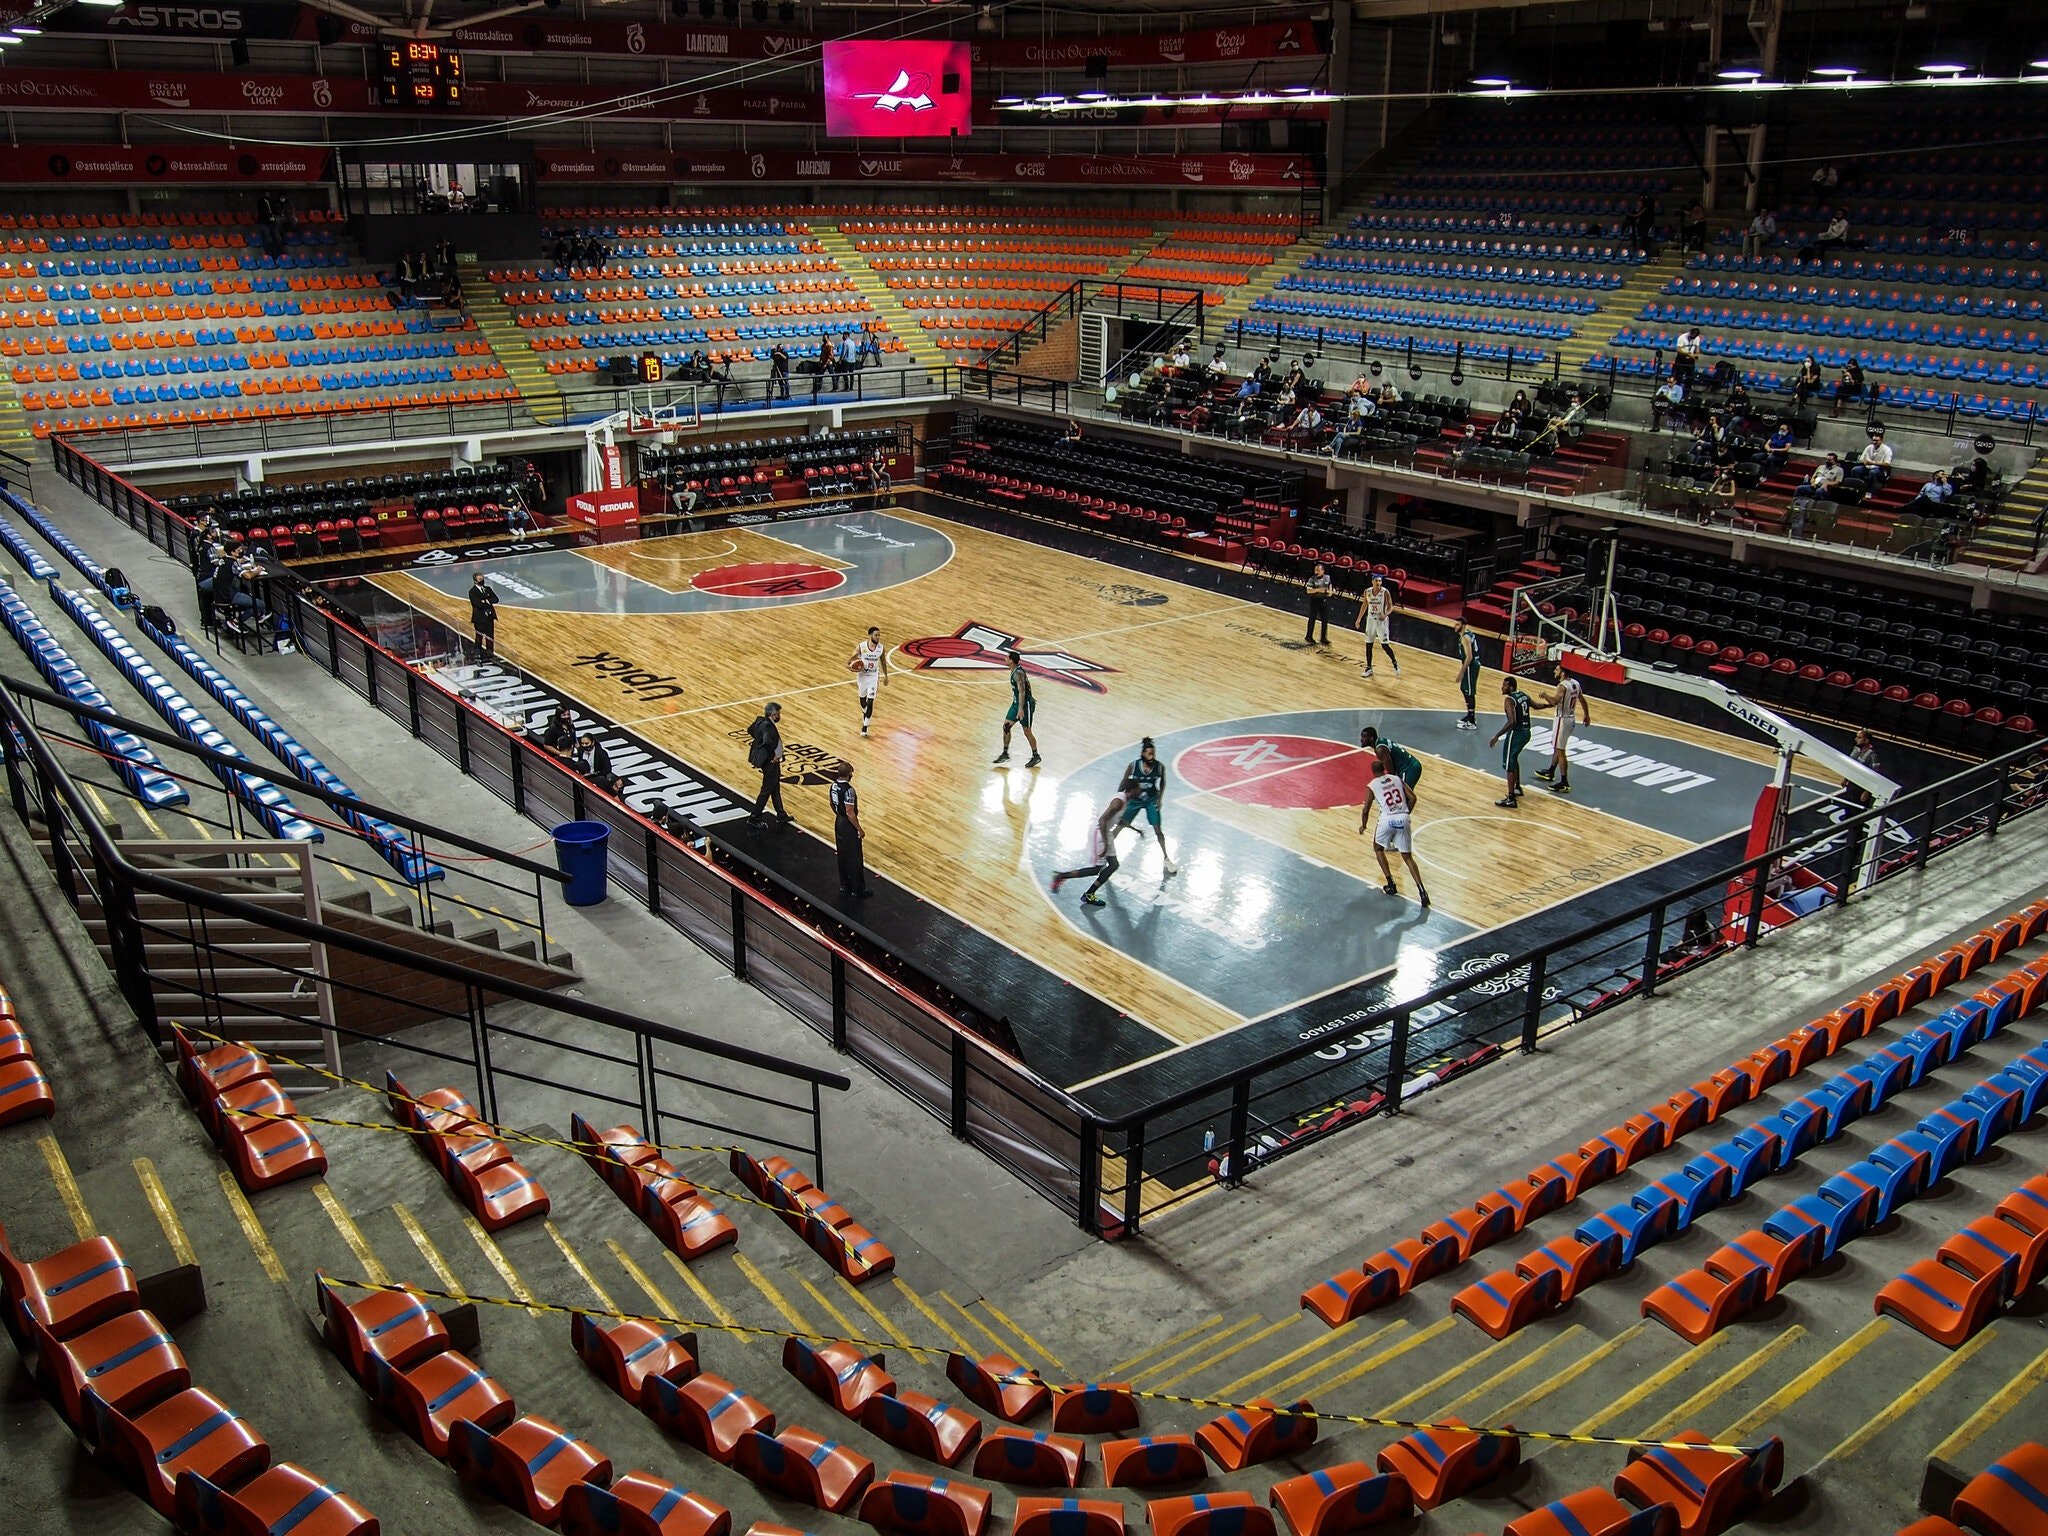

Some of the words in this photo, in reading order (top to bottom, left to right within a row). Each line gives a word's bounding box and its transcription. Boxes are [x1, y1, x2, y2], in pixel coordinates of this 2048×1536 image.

[107, 6, 242, 30] ASTROS
[455, 28, 514, 41] @AstrosJalisco
[547, 32, 592, 45] astrosjalisco
[1215, 30, 1246, 49] Coors
[686, 32, 729, 54] LAAFICIÓN
[409, 43, 438, 59] 8:34
[1220, 47, 1241, 55] LIGHT
[391, 52, 400, 67] 2
[449, 55, 459, 69] 4
[435, 65, 440, 76] 1
[149, 82, 188, 91] POCARI
[241, 80, 285, 98] Coors
[391, 85, 396, 96] 1
[450, 86, 458, 98] 0
[251, 96, 277, 105] LIGHT
[535, 99, 584, 108] SPORELLI
[743, 100, 767, 109] PLAZA
[781, 101, 806, 109] PATRIA
[75, 161, 134, 172] @astrosjalisco
[170, 161, 228, 172] @AstrosJalisco
[261, 161, 306, 173] astrosjalisco
[551, 163, 595, 174] @astrosjalisco
[690, 163, 726, 174] astrosjalisco
[1027, 167, 1045, 177] CHG
[1229, 159, 1255, 174] Coors
[1233, 172, 1250, 180] LIGHT
[1499, 213, 1512, 222] 215
[1948, 229, 1967, 241] 216
[464, 254, 476, 262] 212
[646, 364, 660, 381] 19
[576, 499, 595, 514] PERDURA
[600, 501, 635, 514] PERDURA
[464, 541, 556, 557] CODE
[571, 652, 684, 702] Upick
[1726, 701, 1779, 736] GARED
[1383, 788, 1403, 807] 23
[1343, 1008, 1368, 1023] DEL
[1299, 1017, 1344, 1040] ESTADO
